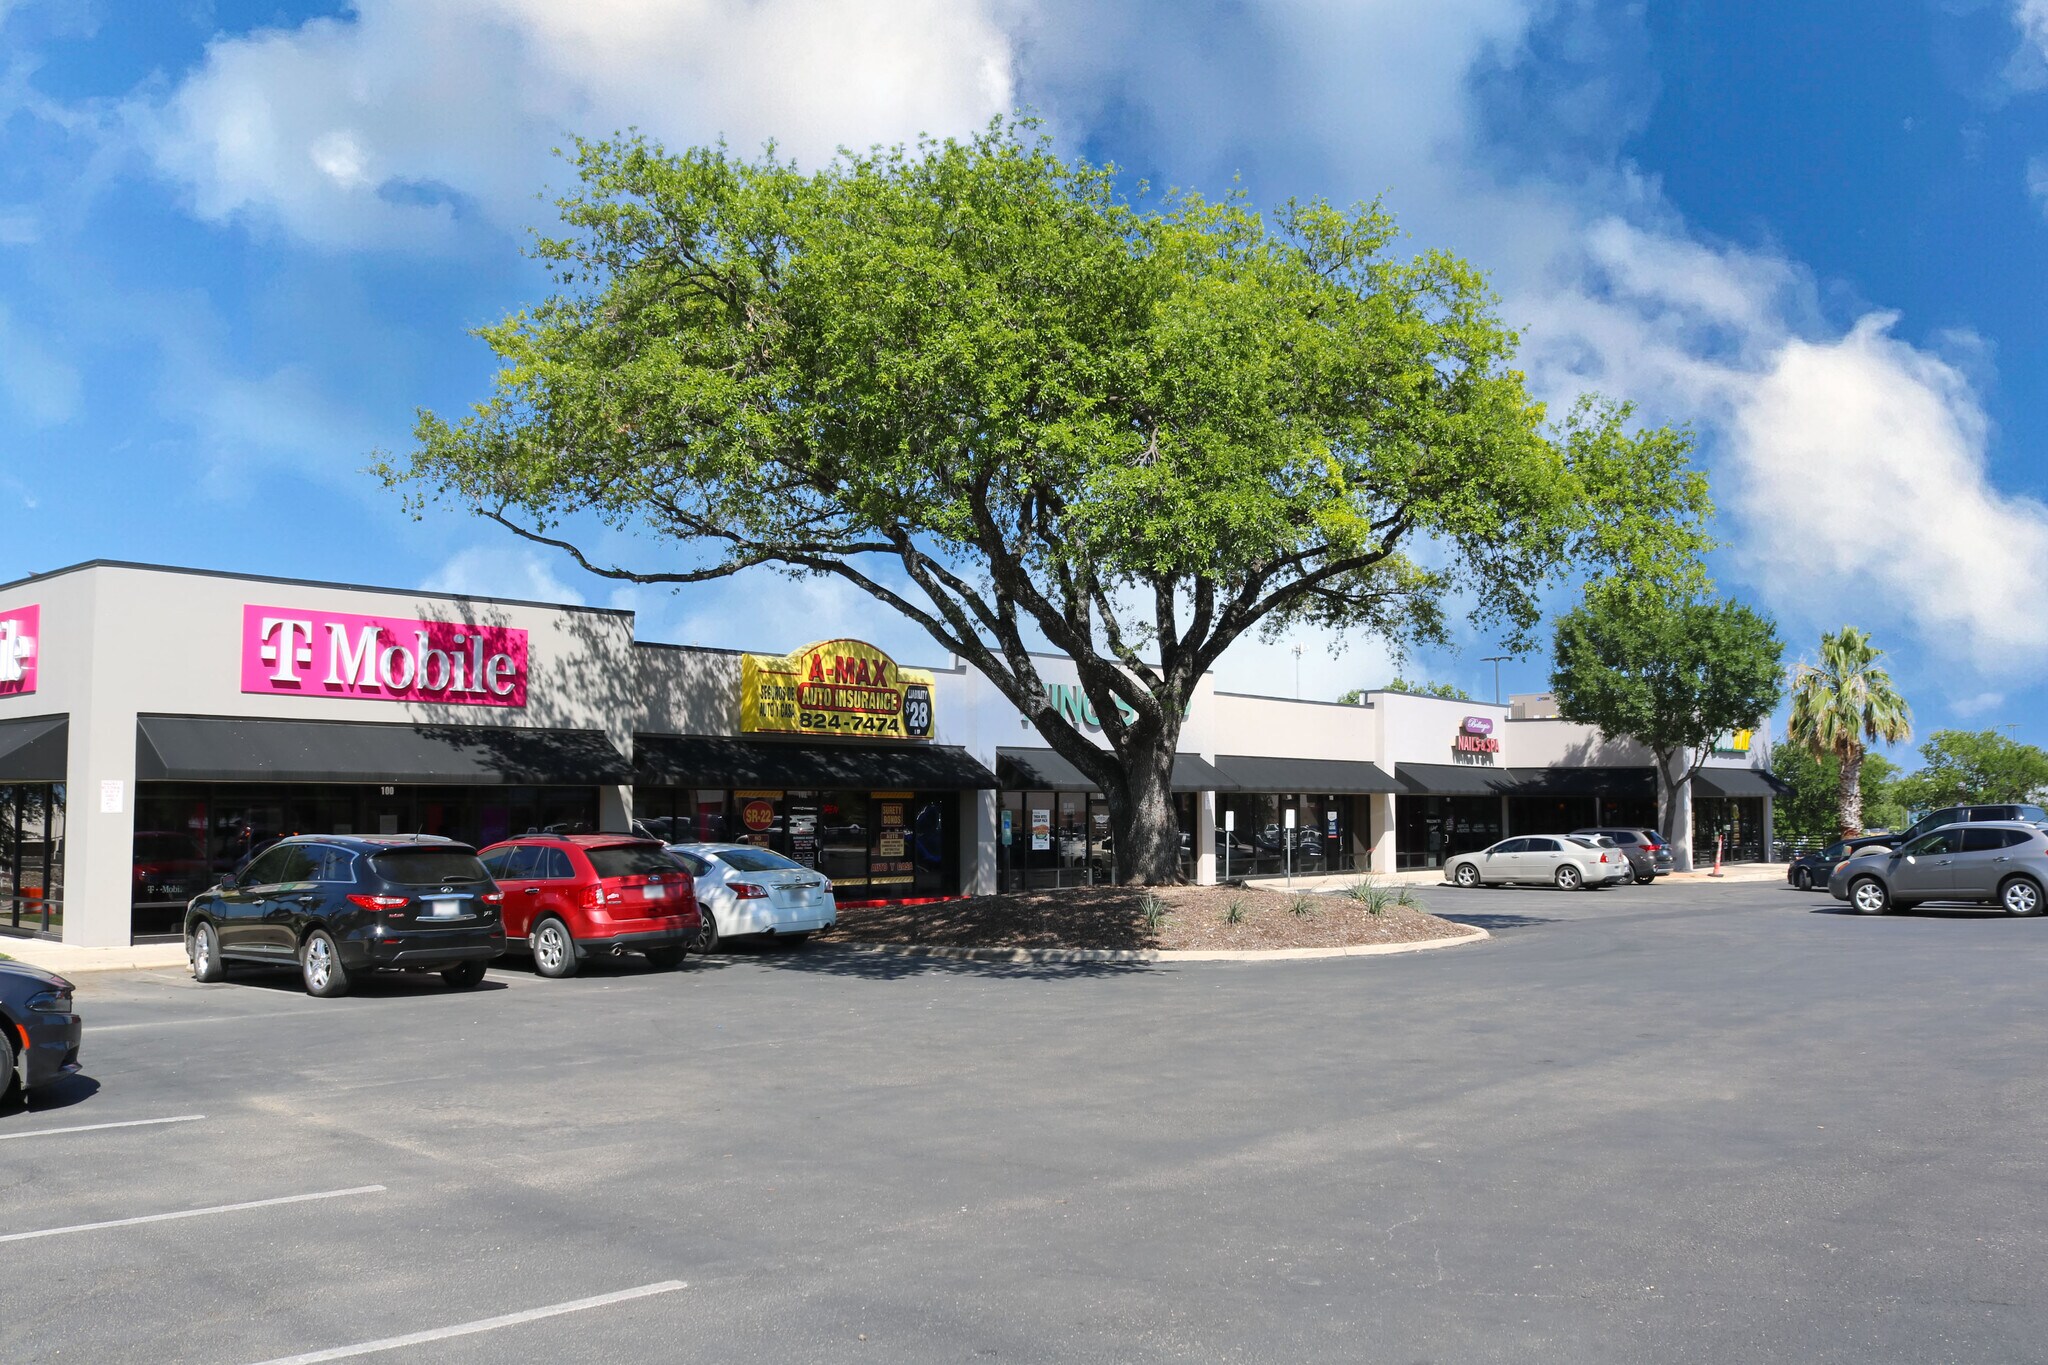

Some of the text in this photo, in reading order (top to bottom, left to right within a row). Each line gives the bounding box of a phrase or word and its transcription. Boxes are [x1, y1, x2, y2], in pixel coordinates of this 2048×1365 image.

[323, 622, 516, 695] Mobile
[808, 653, 888, 687] A-MAX
[801, 686, 897, 711] AUTO INSURANCE
[908, 689, 928, 700] LIABILITY
[800, 713, 900, 732] 824-7474
[380, 786, 395, 795] 100
[745, 808, 772, 823] SR-22
